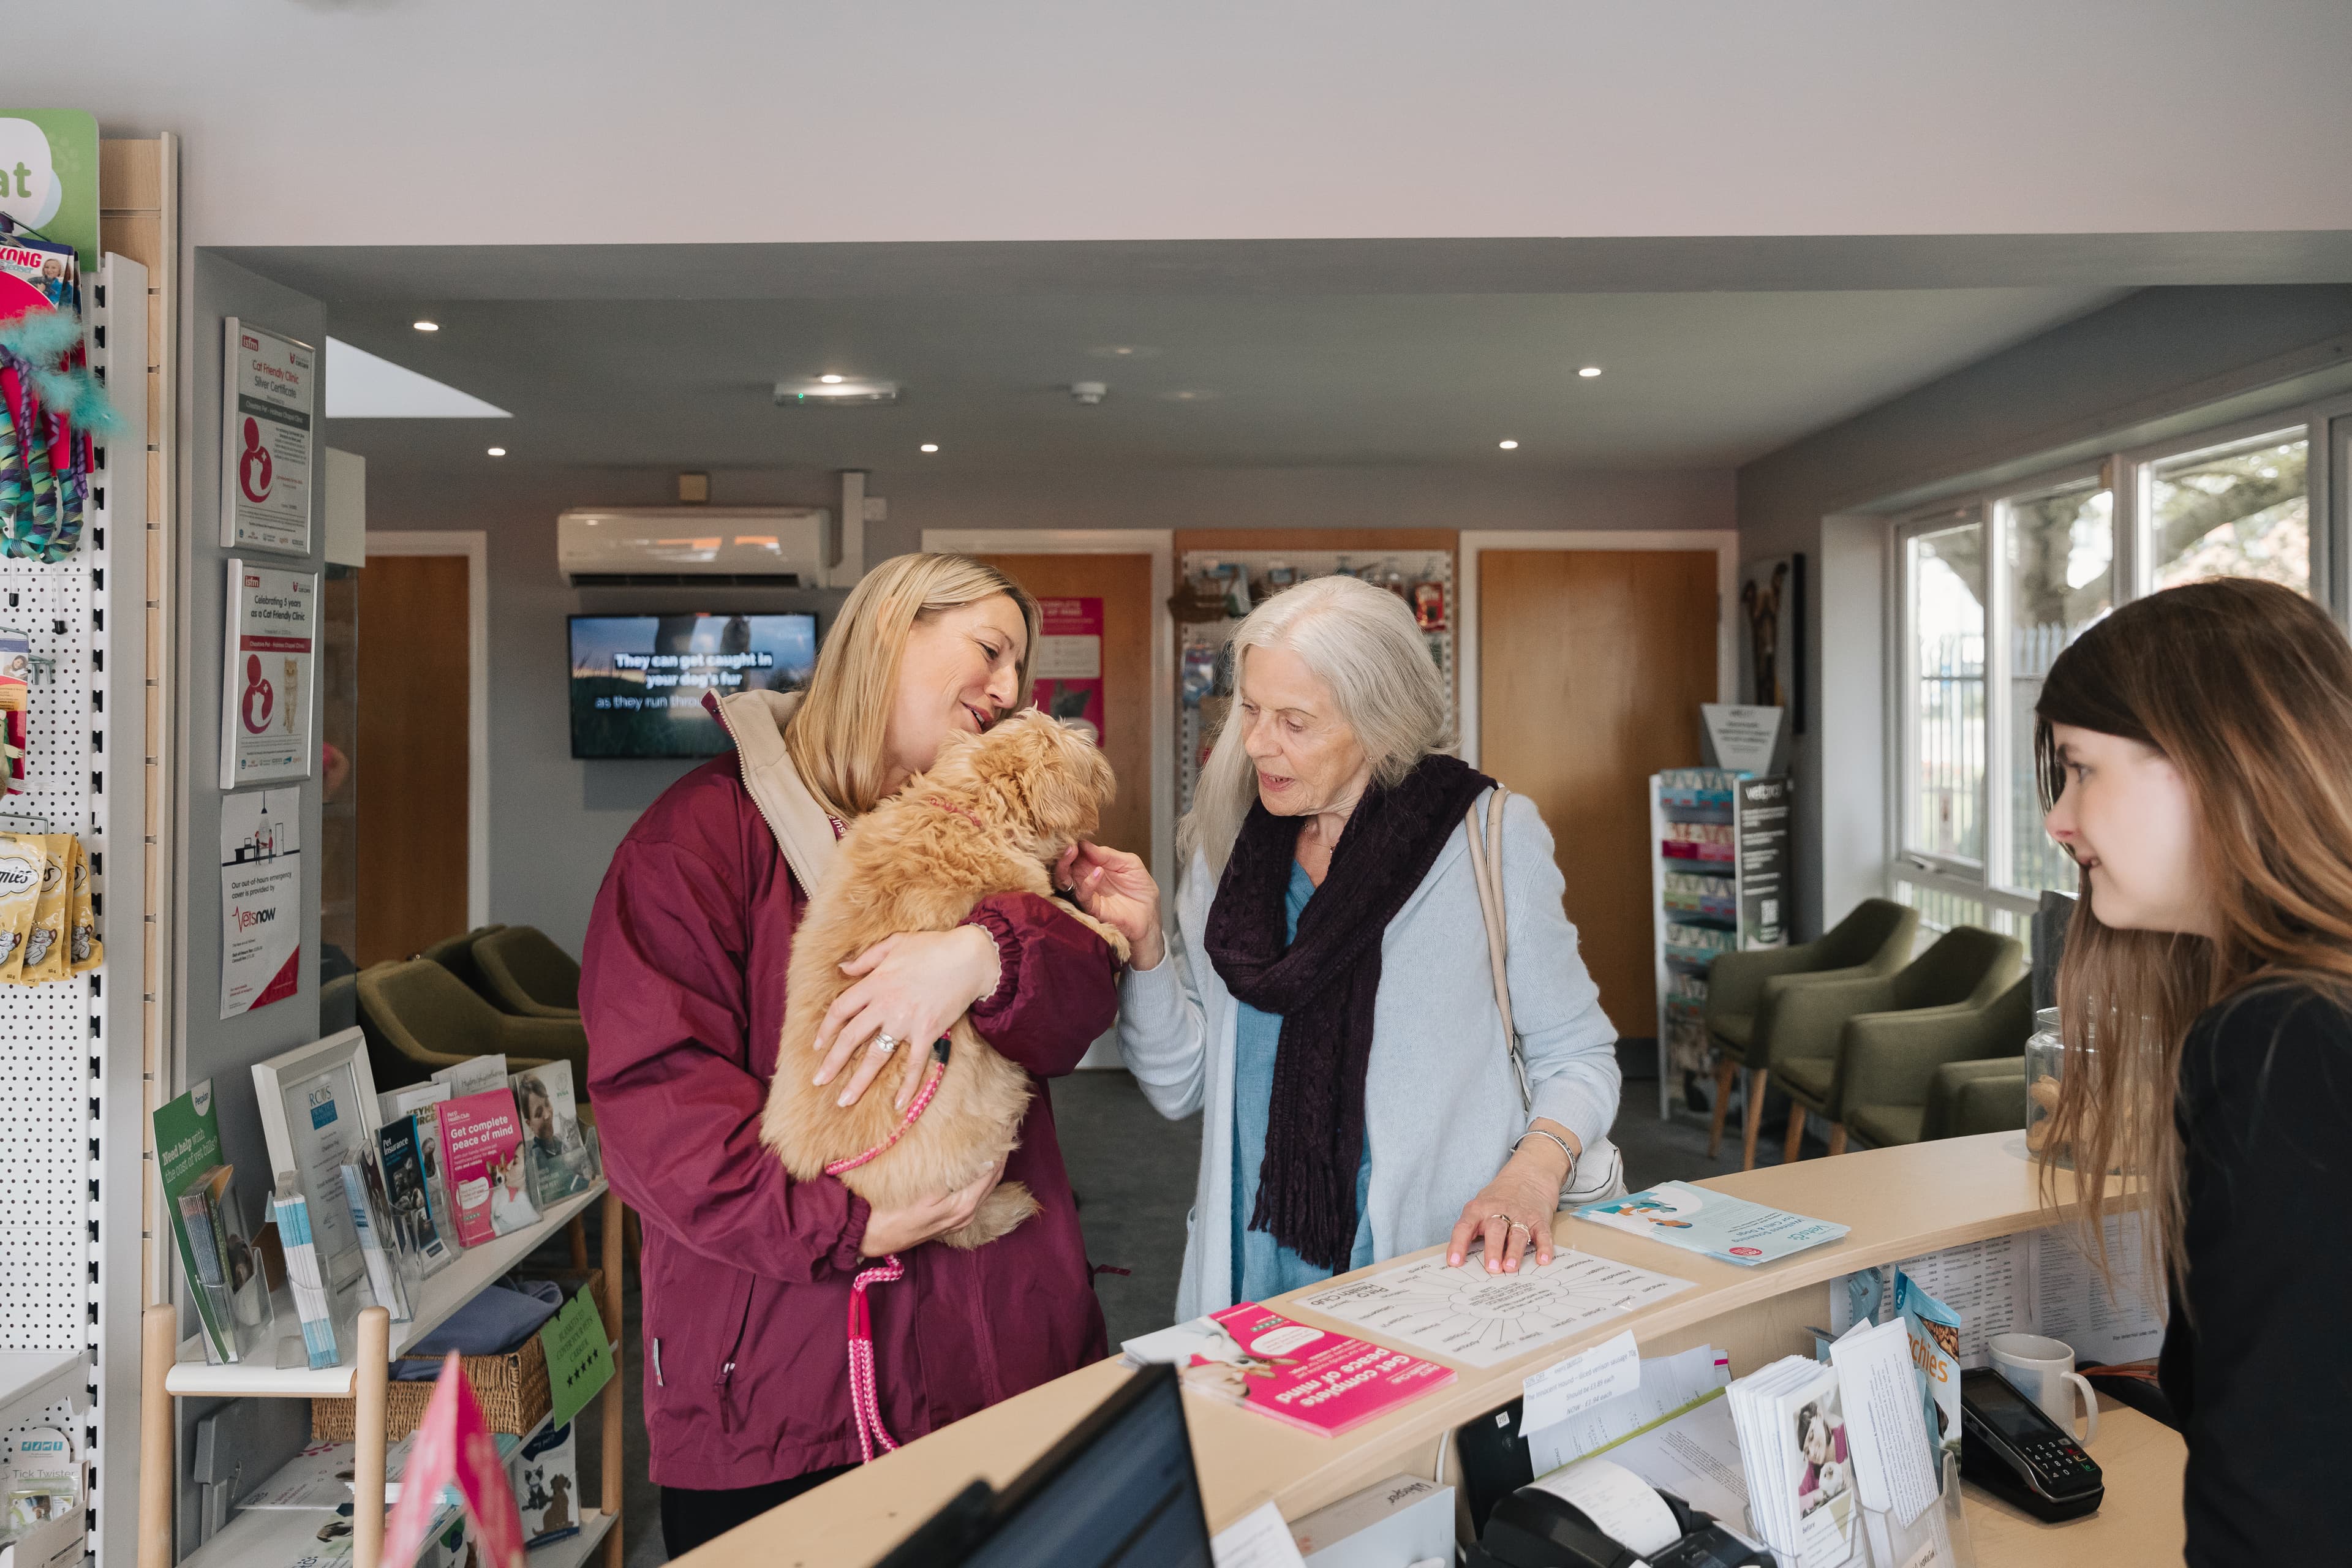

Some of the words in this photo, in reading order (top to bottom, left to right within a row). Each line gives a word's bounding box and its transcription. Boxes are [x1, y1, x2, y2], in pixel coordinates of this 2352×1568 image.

[243, 336, 258, 350] isfm
[252, 360, 263, 371] Cat
[263, 363, 284, 381] Friendly
[285, 371, 299, 385] Clinic
[255, 375, 270, 389] Silver
[270, 381, 297, 398] Certificate
[245, 576, 259, 587] isfm
[254, 595, 283, 608] Celebrating
[284, 598, 287, 606] 5
[288, 600, 301, 608] years
[263, 609, 272, 618] Cat
[273, 610, 292, 622] Friendly
[292, 612, 305, 621] Clinic
[615, 654, 650, 670] They
[651, 655, 678, 668] can
[679, 654, 704, 670] get
[706, 653, 756, 669] caught
[758, 652, 773, 667] in
[646, 674, 678, 689] your
[679, 672, 719, 687] dog's
[720, 672, 742, 685] fur
[595, 698, 611, 709] as
[613, 696, 643, 710] they
[645, 697, 667, 708] run
[241, 877, 269, 887] out-of-hours
[270, 872, 292, 882] emergency
[249, 886, 270, 897] provided
[195, 1092, 209, 1106] Petplan
[451, 1128, 467, 1139] Get
[468, 1115, 508, 1134] complete
[383, 1137, 391, 1148] Pet
[383, 1137, 409, 1155] Insurance
[453, 1137, 479, 1153] peace
[481, 1133, 491, 1142] of
[492, 1124, 513, 1139] mind
[162, 1145, 179, 1166] Need
[179, 1137, 192, 1156] help
[192, 1128, 205, 1146] with
[165, 1169, 176, 1184] the
[176, 1159, 188, 1176] cost
[187, 1153, 194, 1167] of
[193, 1147, 203, 1163] vet
[203, 1136, 218, 1157] bills?
[1766, 1219, 1806, 1231] Wellness
[1796, 1224, 1831, 1235] Vets
[1731, 1231, 1771, 1243] Screening
[1336, 1284, 1378, 1295] Health
[1308, 1295, 1342, 1305] Club
[1337, 1348, 1391, 1373] peace
[1373, 1354, 1412, 1371] Get
[1406, 1362, 1433, 1374] Health
[1317, 1370, 1346, 1382] of
[1389, 1373, 1412, 1384] Club
[1525, 1392, 1535, 1401] The
[1536, 1385, 1557, 1398] Innocent
[1558, 1378, 1574, 1390] Hound
[1593, 1363, 1610, 1375] venison
[1610, 1354, 1628, 1368] sausage
[1628, 1349, 1637, 1358] 70g
[1273, 1379, 1325, 1403] mind
[1299, 1369, 1379, 1406] complete
[1566, 1388, 1582, 1401] Should
[1583, 1385, 1589, 1395] be
[1602, 1374, 1615, 1385] each
[1566, 1404, 1580, 1415] NOW
[1600, 1390, 1613, 1401] each
[37, 1470, 74, 1479] Twister
[1387, 1482, 1433, 1504] Whisper
